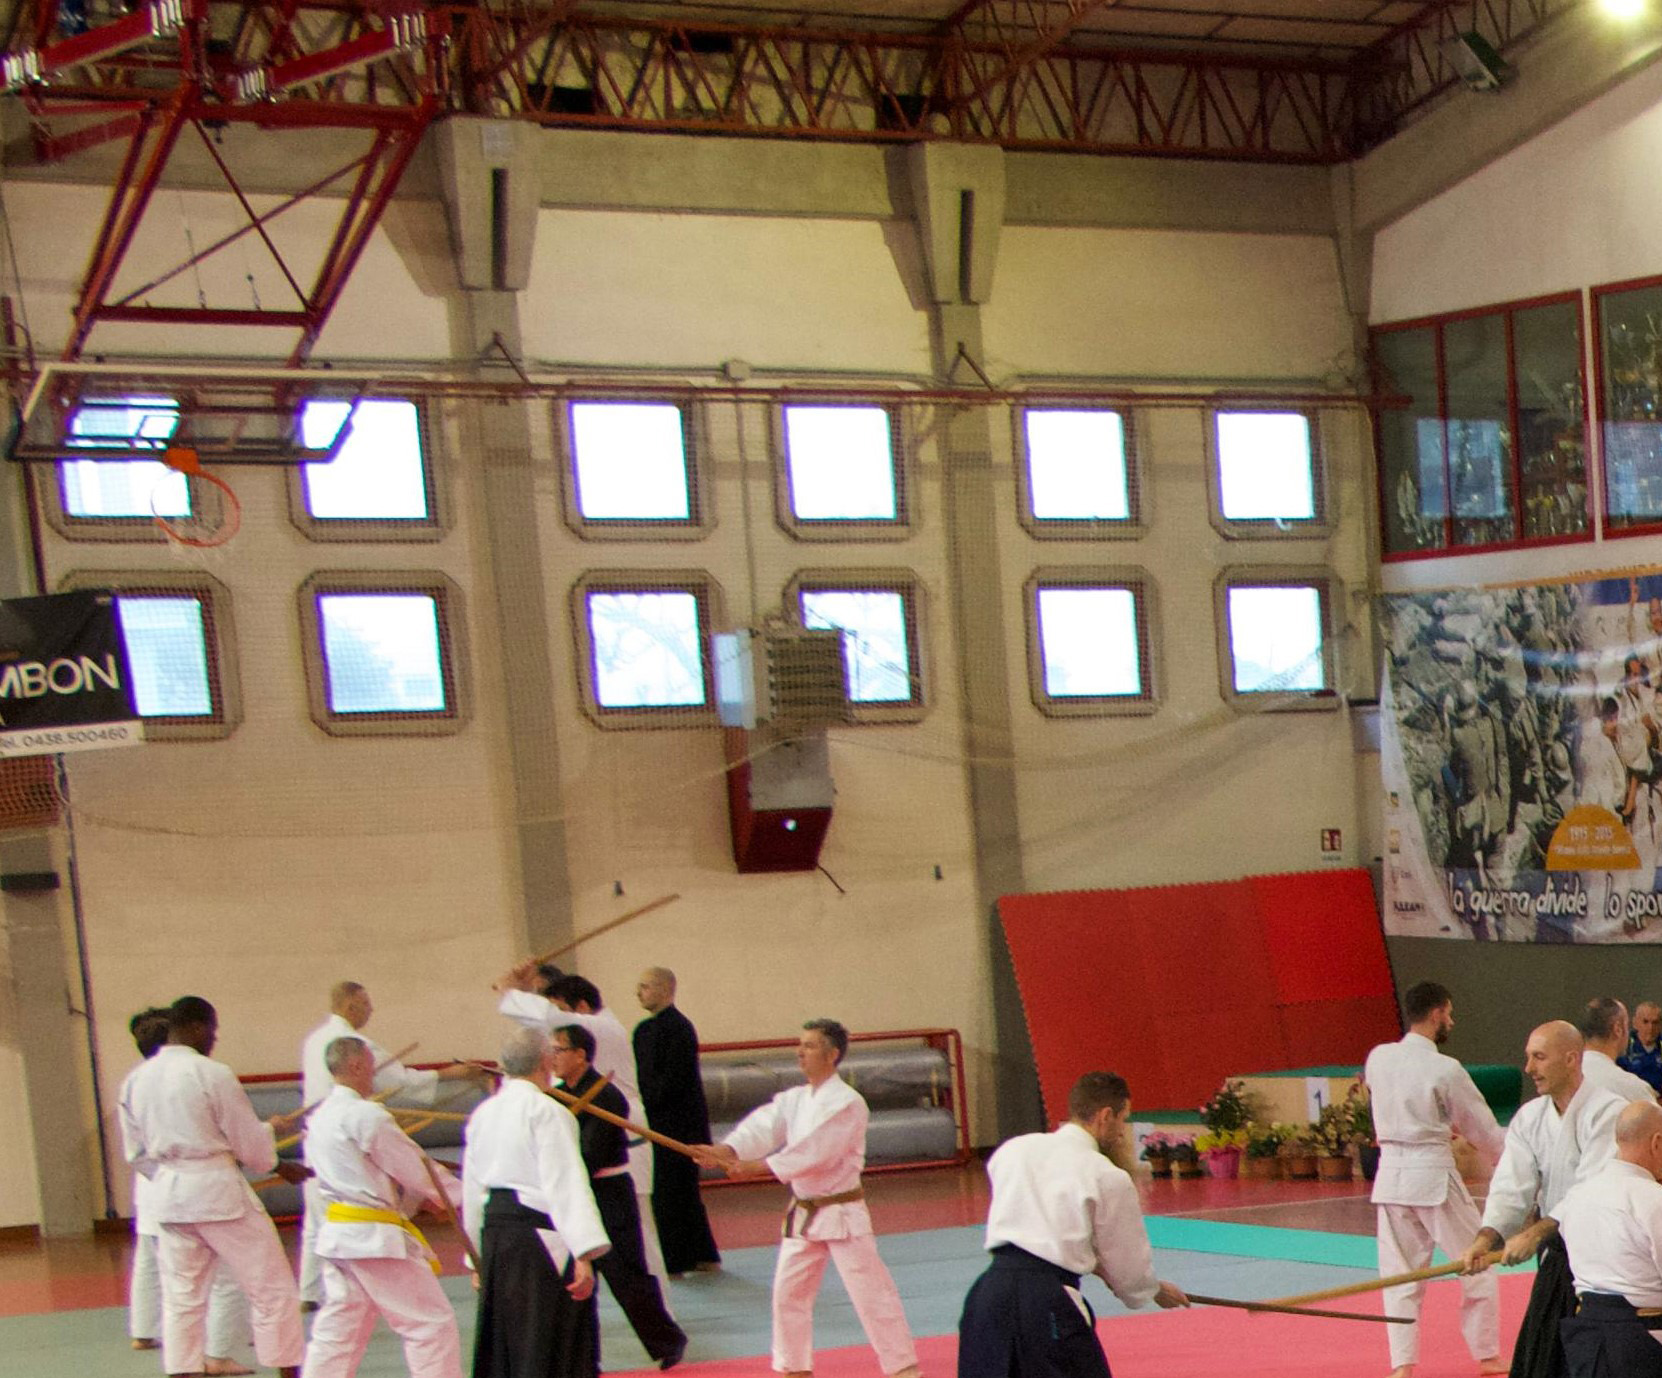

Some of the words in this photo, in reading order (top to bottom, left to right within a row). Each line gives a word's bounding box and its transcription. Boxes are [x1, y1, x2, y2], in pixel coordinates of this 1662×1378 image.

[1448, 872, 1465, 915] la
[1470, 887, 1532, 921] guerra
[1535, 874, 1588, 918] divide
[1603, 872, 1622, 920] lo
